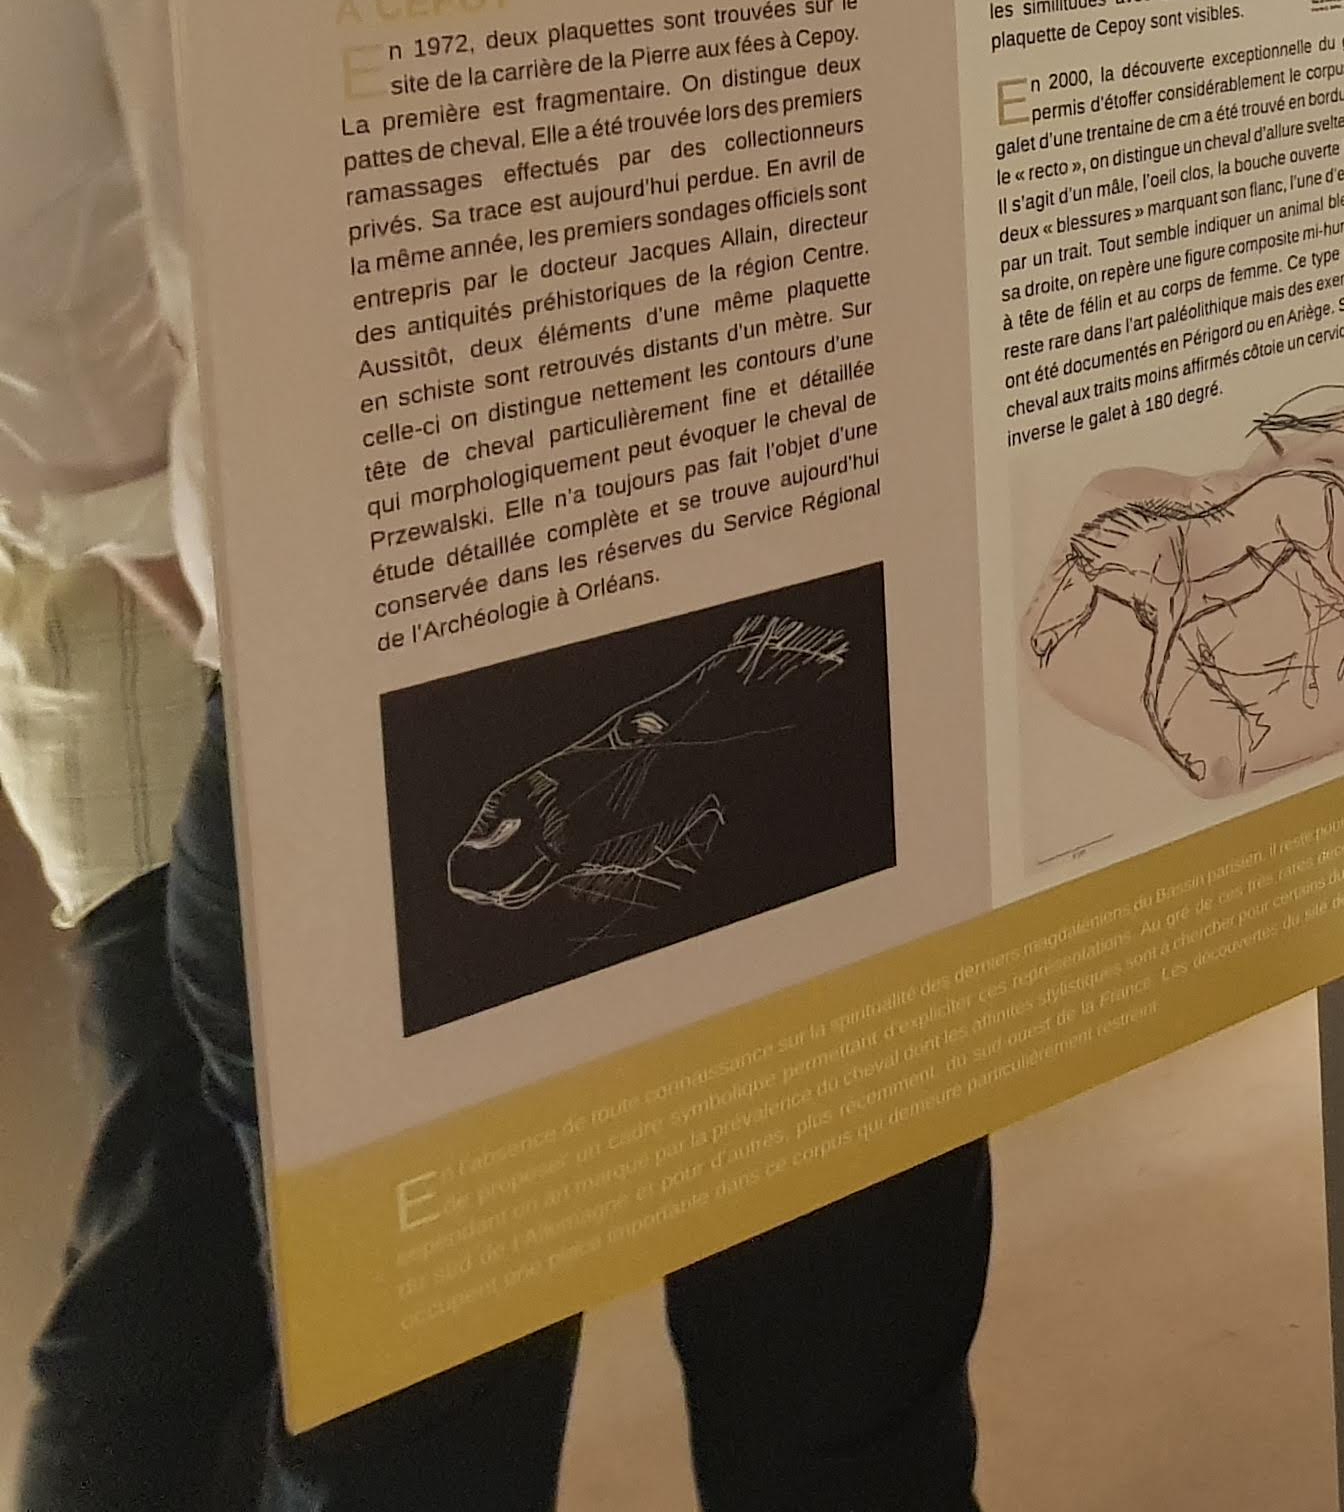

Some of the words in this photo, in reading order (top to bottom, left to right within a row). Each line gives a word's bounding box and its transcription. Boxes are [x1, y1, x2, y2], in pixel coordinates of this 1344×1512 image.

[989, 2, 1014, 20] les
[990, 26, 1067, 54] plaquette
[1070, 21, 1091, 40] de
[1095, 16, 1147, 37] Cepoy
[1150, 10, 1183, 30] sont
[1185, 4, 1245, 25] visibles.
[346, 172, 483, 207] ramassages
[503, 153, 599, 184] effectués
[618, 148, 651, 172] par
[670, 140, 707, 160] des
[724, 118, 864, 152] collectionneurs
[358, 346, 454, 380] Aussitôt,
[469, 335, 523, 359] deux
[537, 315, 632, 346] éléments
[645, 302, 700, 326] d'une
[714, 289, 774, 313] même
[786, 270, 871, 305] plaquette
[1007, 420, 1066, 448] inverse
[1069, 414, 1085, 433] le
[1088, 403, 1127, 431] galet
[1130, 399, 1141, 417] à
[1144, 391, 1174, 414] 180
[1176, 379, 1224, 406] degré.
[374, 576, 489, 618] conservée
[497, 562, 550, 589] dans
[558, 553, 589, 574] les
[597, 530, 683, 565] réserves
[690, 521, 715, 541] du
[723, 503, 794, 533] Service
[801, 477, 881, 515] Régional
